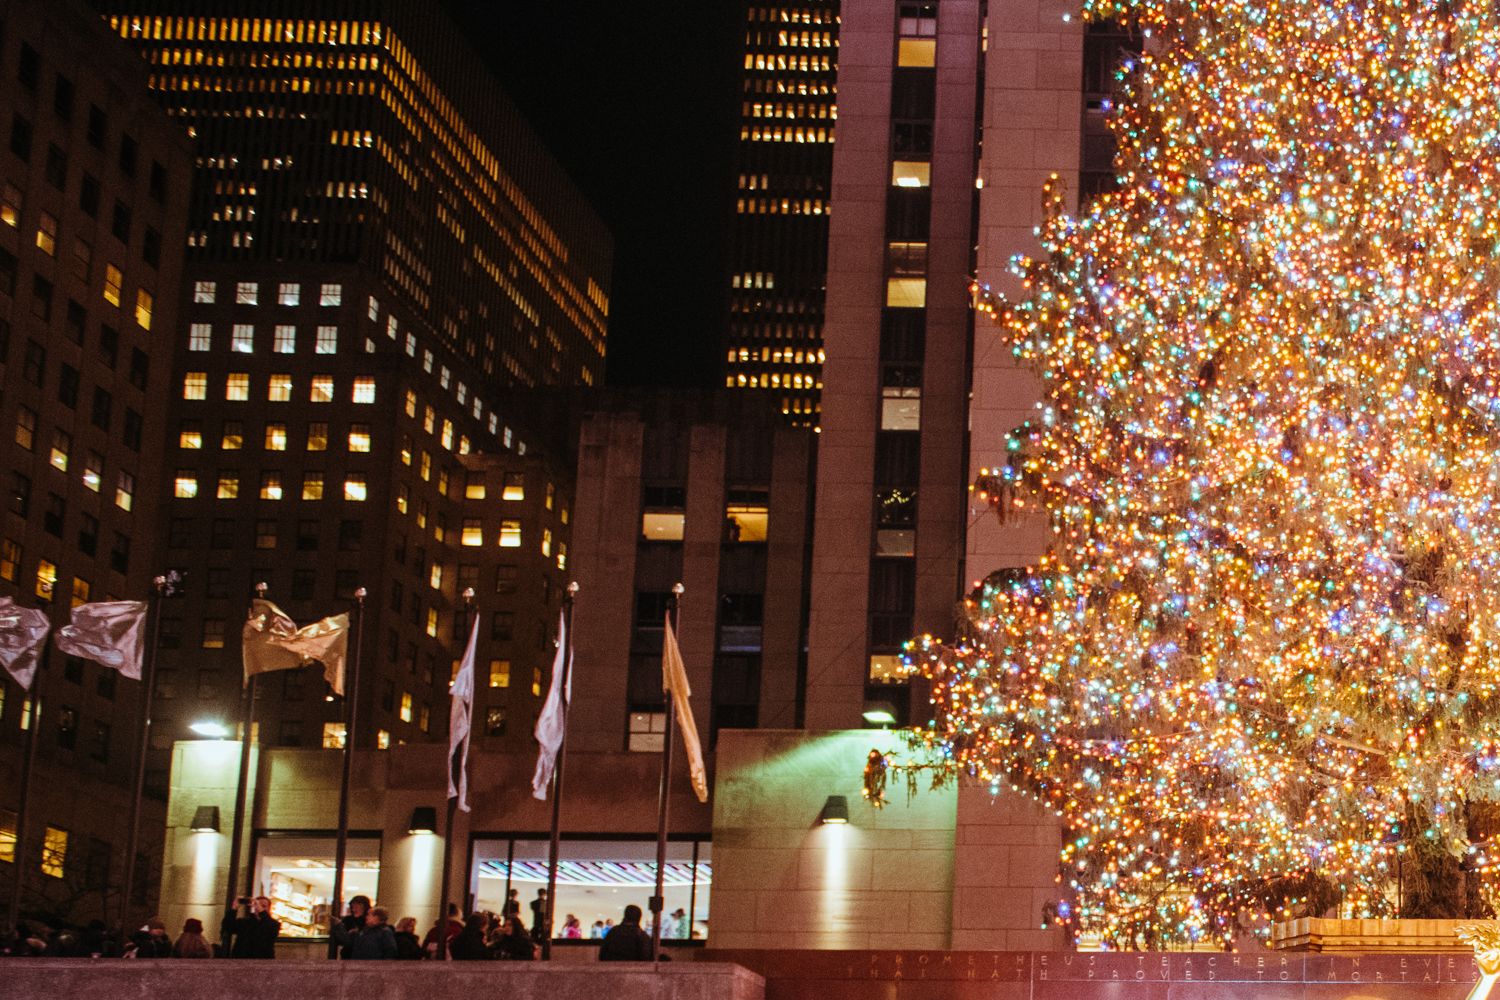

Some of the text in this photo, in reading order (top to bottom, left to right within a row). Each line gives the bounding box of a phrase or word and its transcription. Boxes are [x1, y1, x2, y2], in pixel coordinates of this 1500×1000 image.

[871, 954, 1095, 966] PROMETHEUS
[1136, 956, 1289, 968] TEACHER
[1329, 957, 1361, 969] IN
[966, 968, 1048, 980] HATH
[1087, 969, 1217, 981] PROVED
[1256, 970, 1290, 981] TO
[1327, 971, 1478, 983] MORTALS
